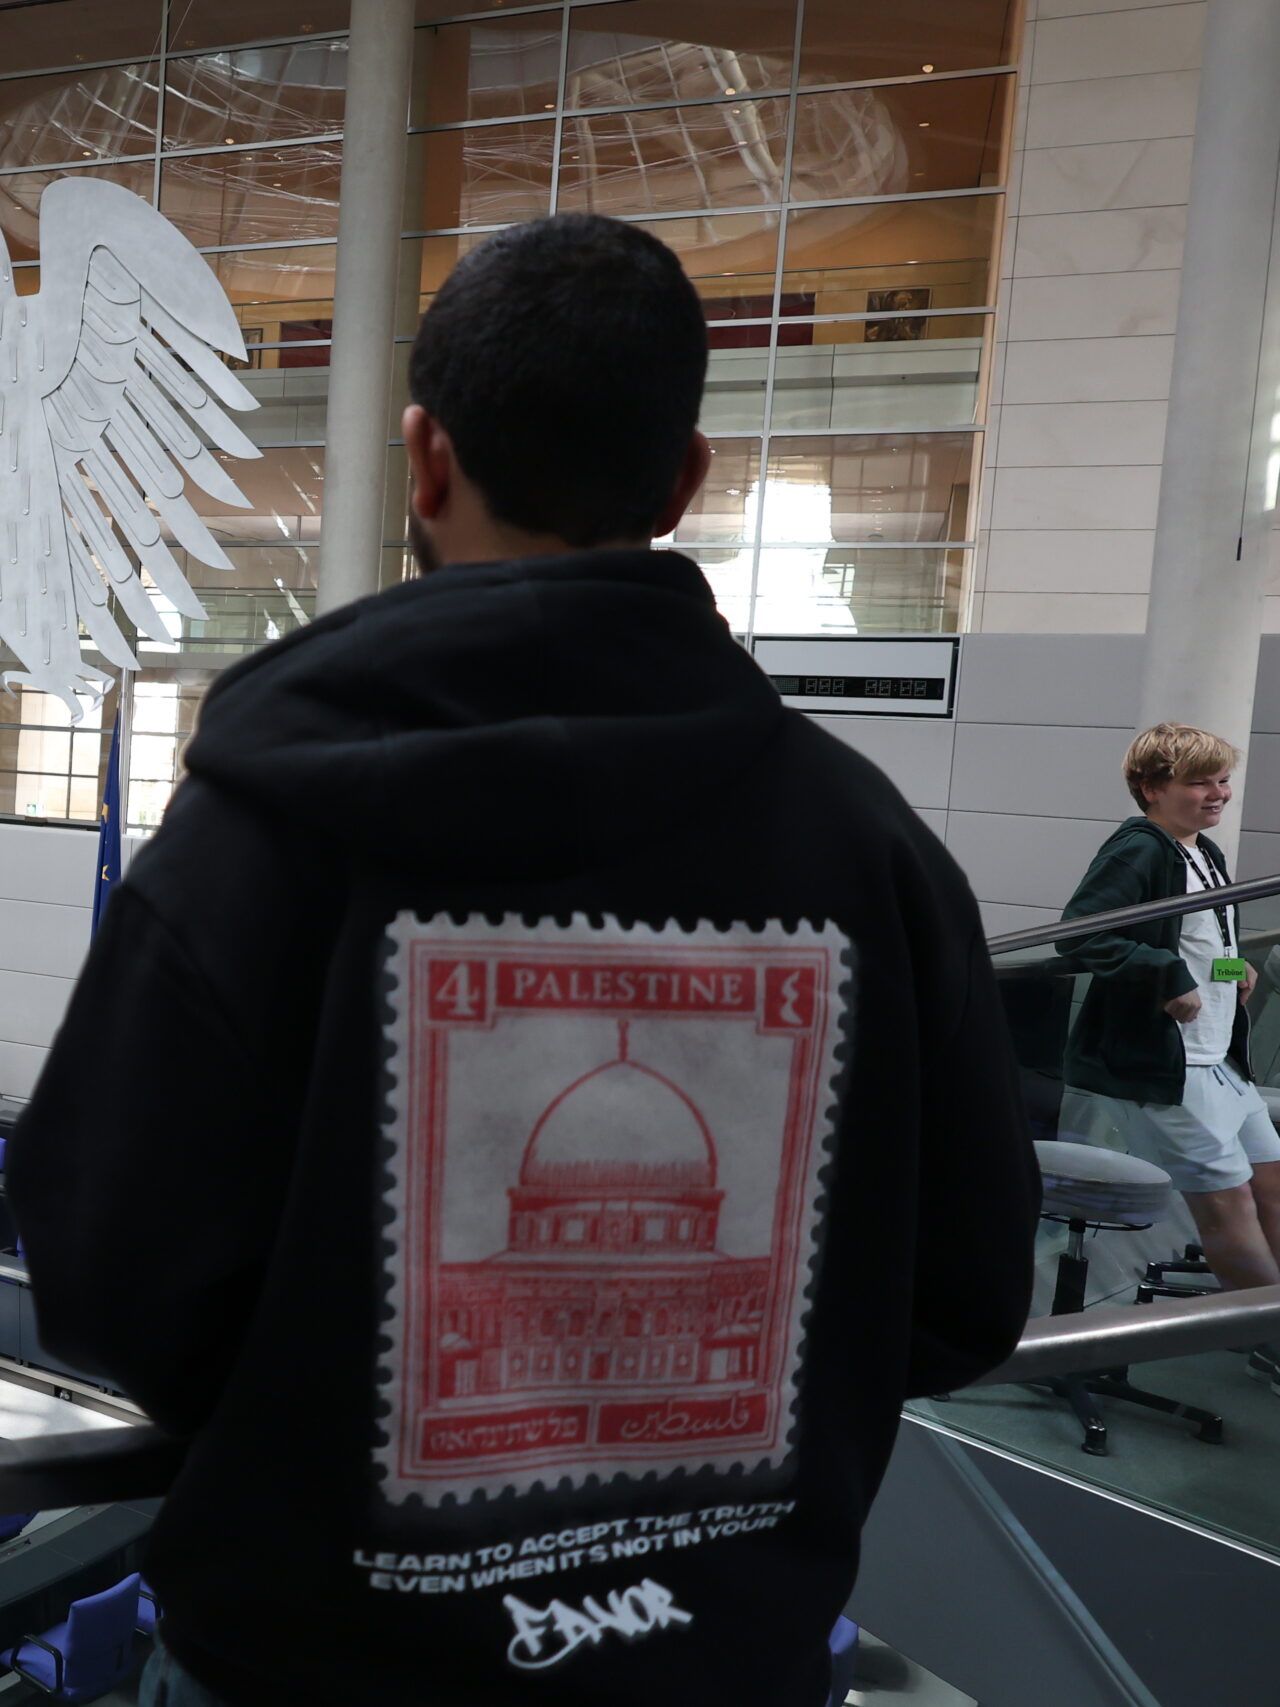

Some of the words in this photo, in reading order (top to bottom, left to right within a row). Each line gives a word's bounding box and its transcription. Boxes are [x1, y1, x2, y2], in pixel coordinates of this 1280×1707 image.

[435, 961, 481, 1017] 4
[513, 968, 744, 1006] PALESTINE
[353, 1549, 471, 1572] LEARN
[476, 1543, 513, 1566] TO
[520, 1519, 629, 1556] ACCEPT
[635, 1513, 692, 1532] THE
[698, 1501, 795, 1523] TRUTH
[370, 1572, 466, 1593] EVEN
[471, 1555, 555, 1589] WHEN
[612, 1534, 668, 1558] NOT
[673, 1527, 701, 1548] IN
[706, 1516, 778, 1539] YOUR
[502, 1577, 694, 1669] FAVOR
